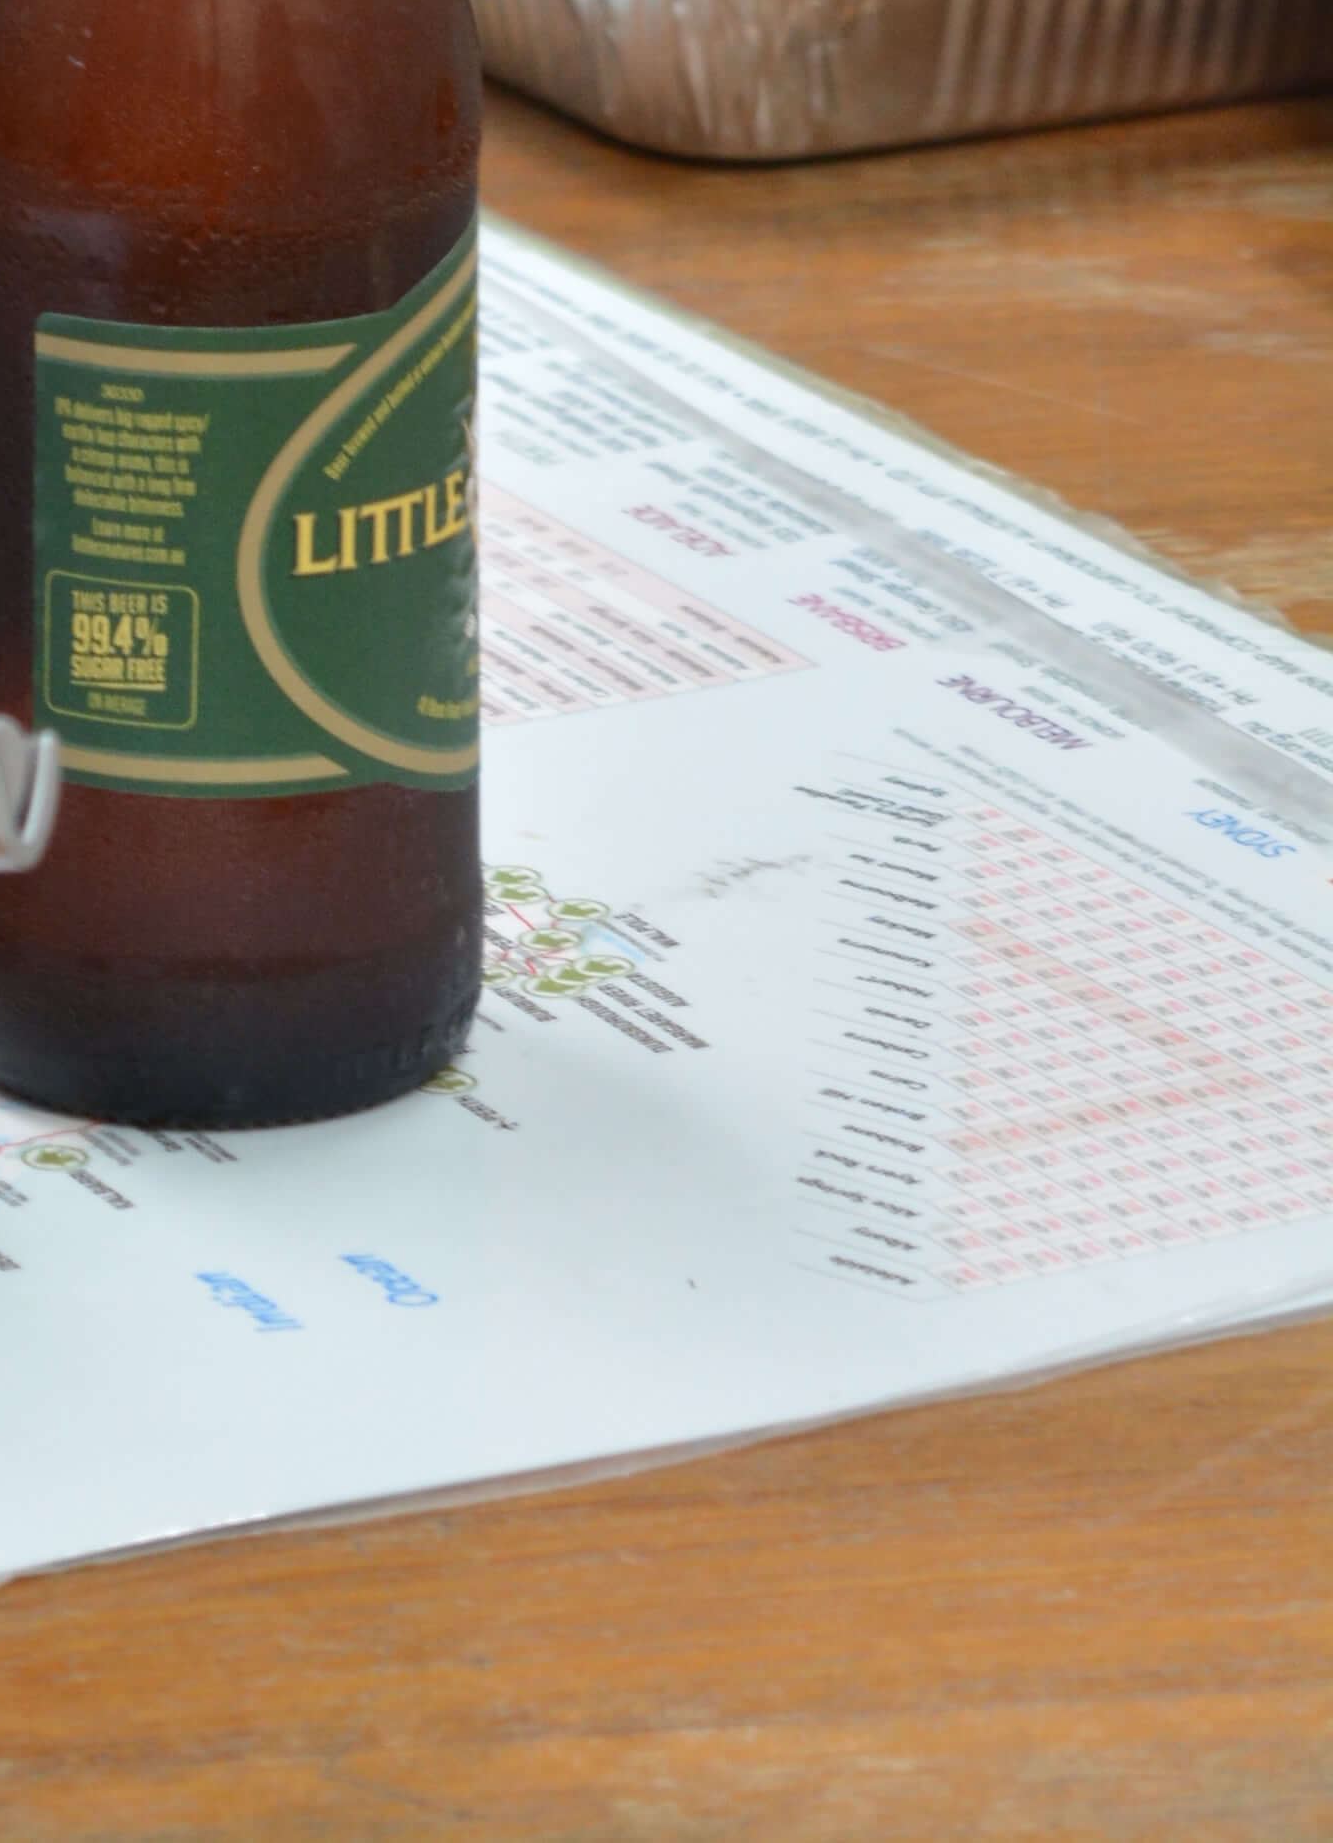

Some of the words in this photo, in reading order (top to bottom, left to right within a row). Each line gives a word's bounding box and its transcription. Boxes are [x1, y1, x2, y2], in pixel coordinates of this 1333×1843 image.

[292, 468, 468, 576] LITTLE
[71, 589, 106, 611] THIS
[108, 591, 147, 614] BEER
[149, 593, 169, 615] IS
[71, 613, 170, 657] 99.4%
[70, 653, 125, 680] SUGAR
[126, 657, 167, 683] FREE
[937, 675, 1090, 750] MELBOURNE
[1191, 810, 1296, 857] SYDNEY
